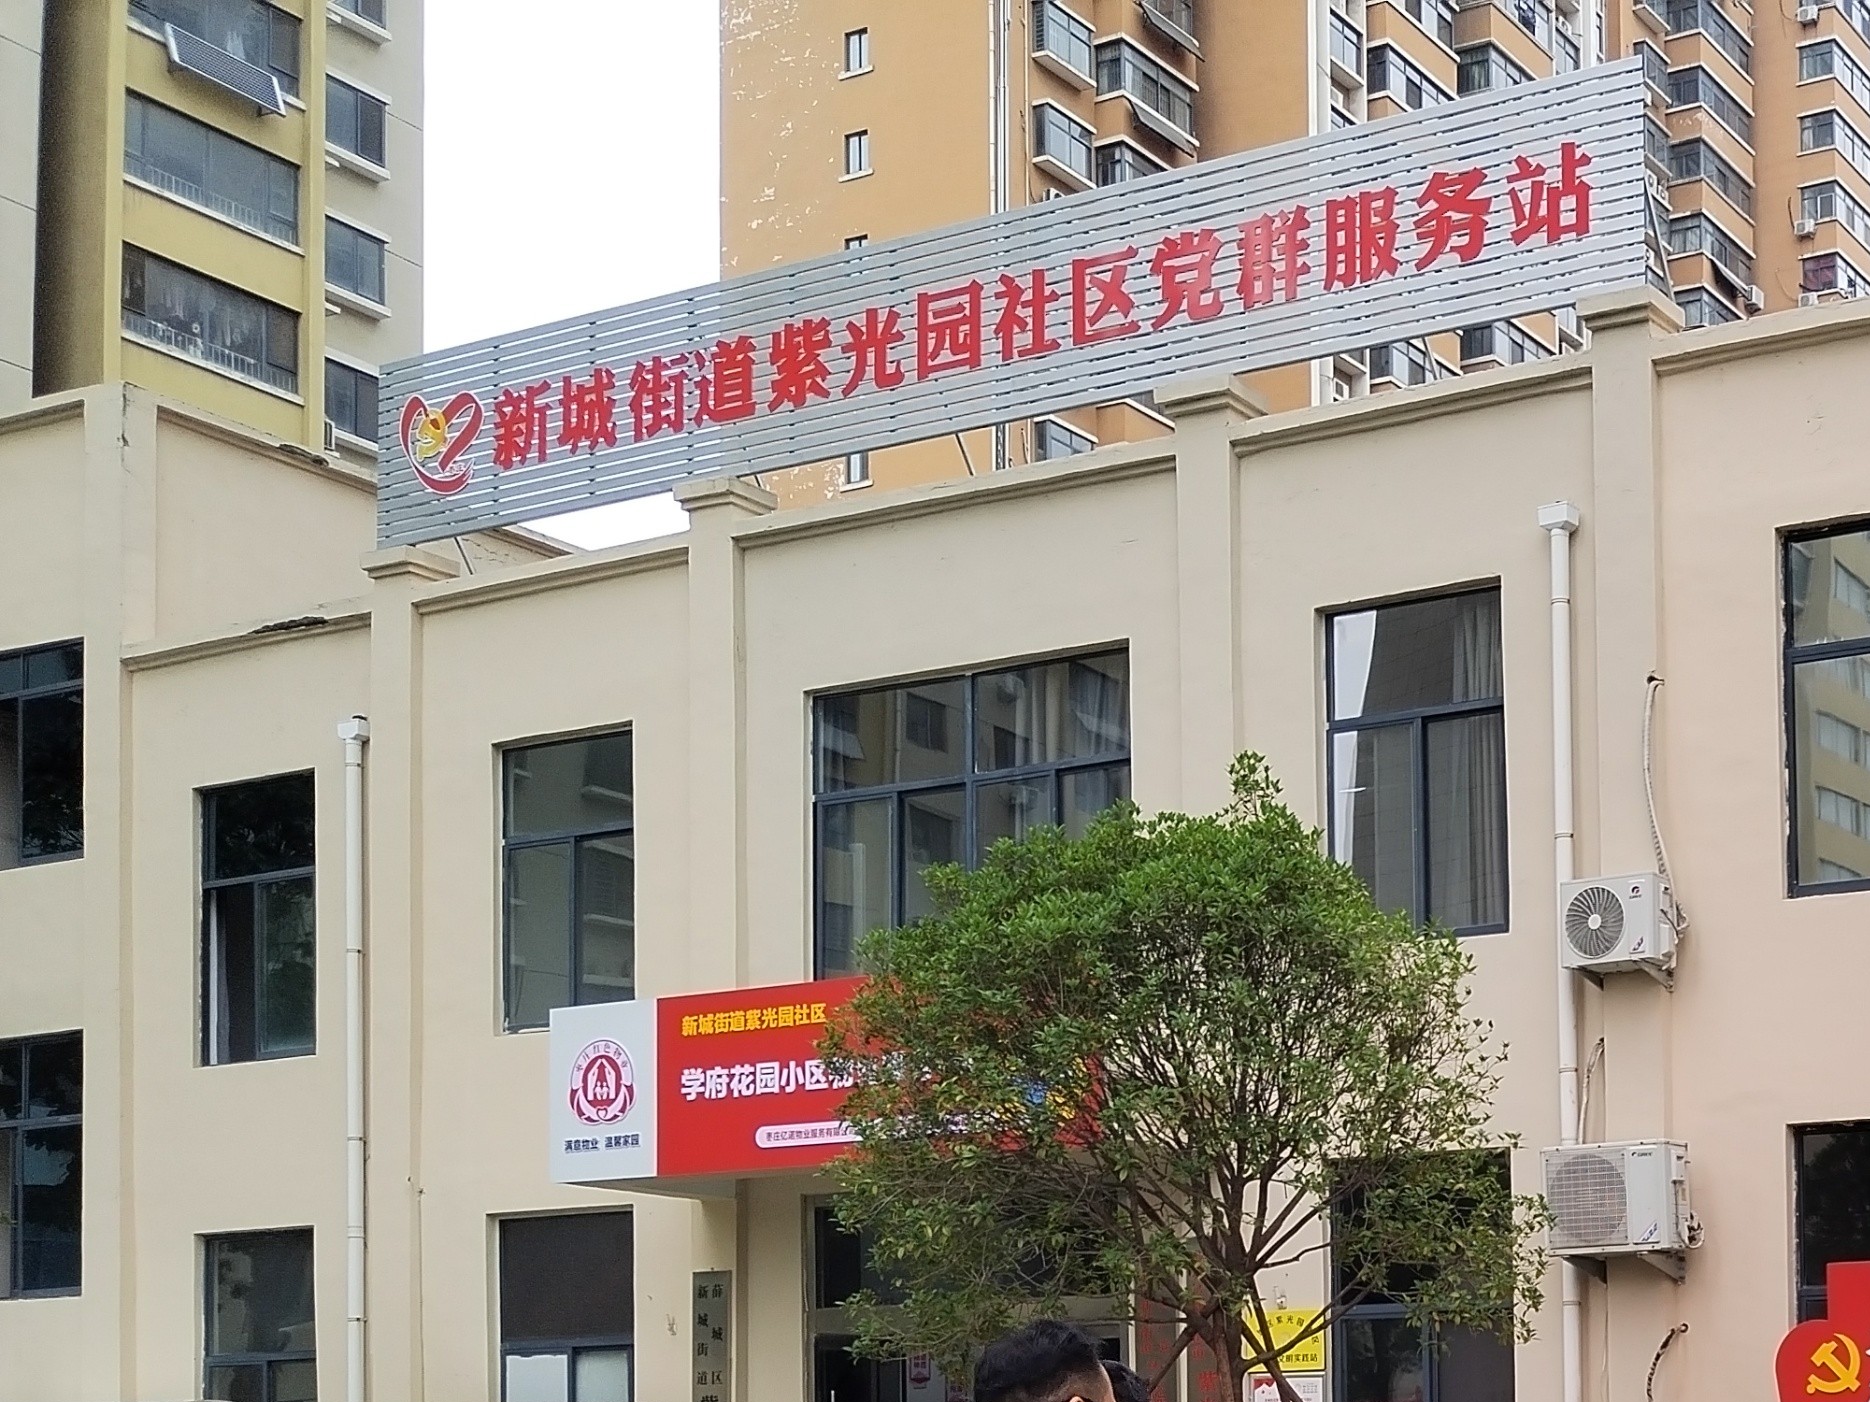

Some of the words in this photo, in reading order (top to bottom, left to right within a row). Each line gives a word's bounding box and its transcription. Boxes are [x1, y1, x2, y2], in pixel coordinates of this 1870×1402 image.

[493, 141, 1593, 471] 新城街道紫光园社区党群服务站
[682, 1003, 827, 1036] 新城街道紫光园社区
